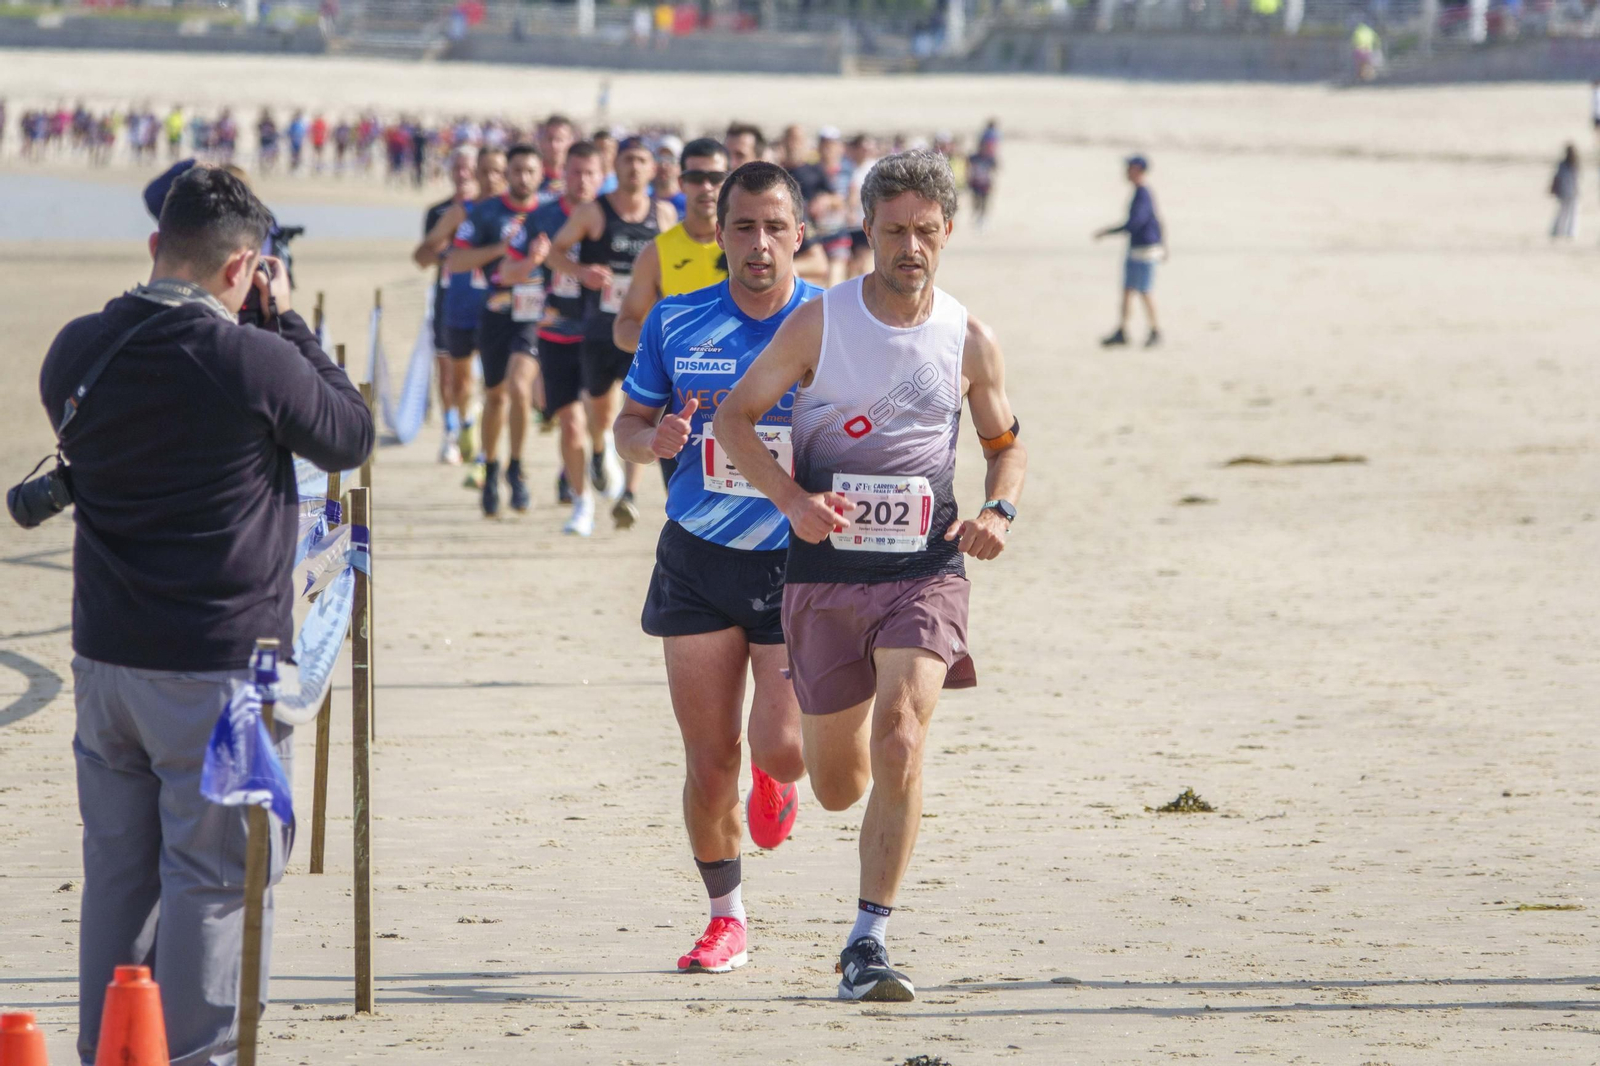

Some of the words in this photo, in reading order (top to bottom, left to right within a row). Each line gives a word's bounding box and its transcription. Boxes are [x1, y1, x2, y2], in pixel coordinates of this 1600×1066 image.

[689, 345, 723, 353] MERCURY
[676, 360, 732, 371] DISMAC
[854, 500, 910, 526] 202
